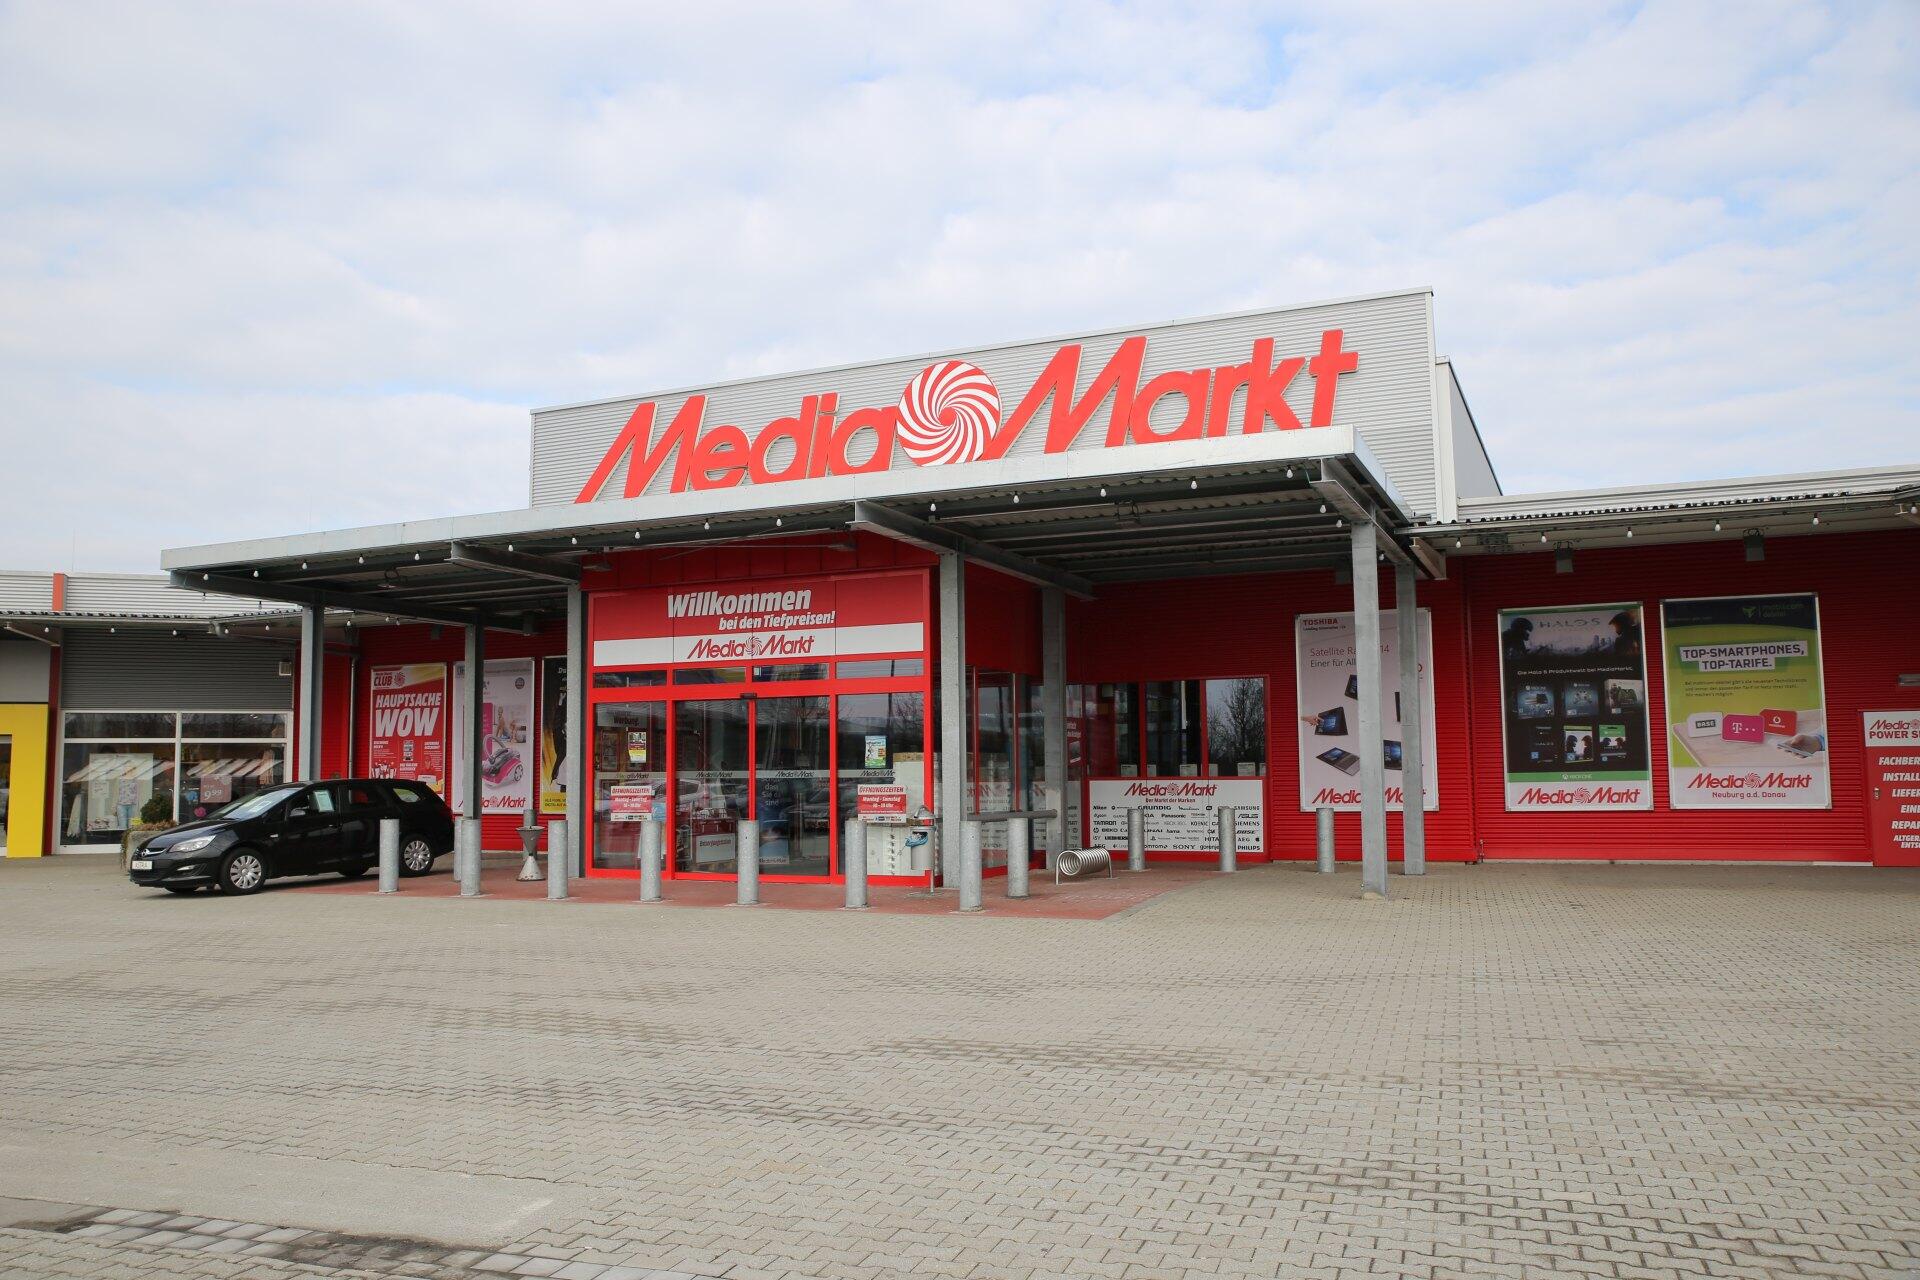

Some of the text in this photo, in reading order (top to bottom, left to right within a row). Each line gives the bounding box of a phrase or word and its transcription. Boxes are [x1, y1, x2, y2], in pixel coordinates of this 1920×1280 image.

[574, 329, 1359, 504] Media Markt
[667, 589, 812, 618] Willkommen
[719, 611, 836, 631] bei den Tiefpreisen!
[1303, 618, 1338, 626] TOSHIBA
[687, 635, 815, 659] Media Markt
[1310, 647, 1344, 657] Satellite
[1683, 644, 1805, 659] TOP-SMARTPHONES,
[1310, 659, 1357, 668] Einer für All
[1702, 658, 1772, 670] TOP-TARIFE.
[374, 674, 393, 687] CLUB
[376, 692, 442, 708] HAUPTSACHE
[376, 708, 440, 738] WOW
[1697, 720, 1715, 728] BASE
[1870, 720, 1910, 730] Media
[1869, 731, 1908, 739] POWER
[1688, 773, 1812, 789] Media Markt
[1124, 782, 1217, 796] Media Markt
[1518, 786, 1640, 804] Media Markt
[1712, 791, 1745, 800] Neuburg
[497, 795, 526, 808] Markt
[1893, 834, 1920, 842] ALTGER
